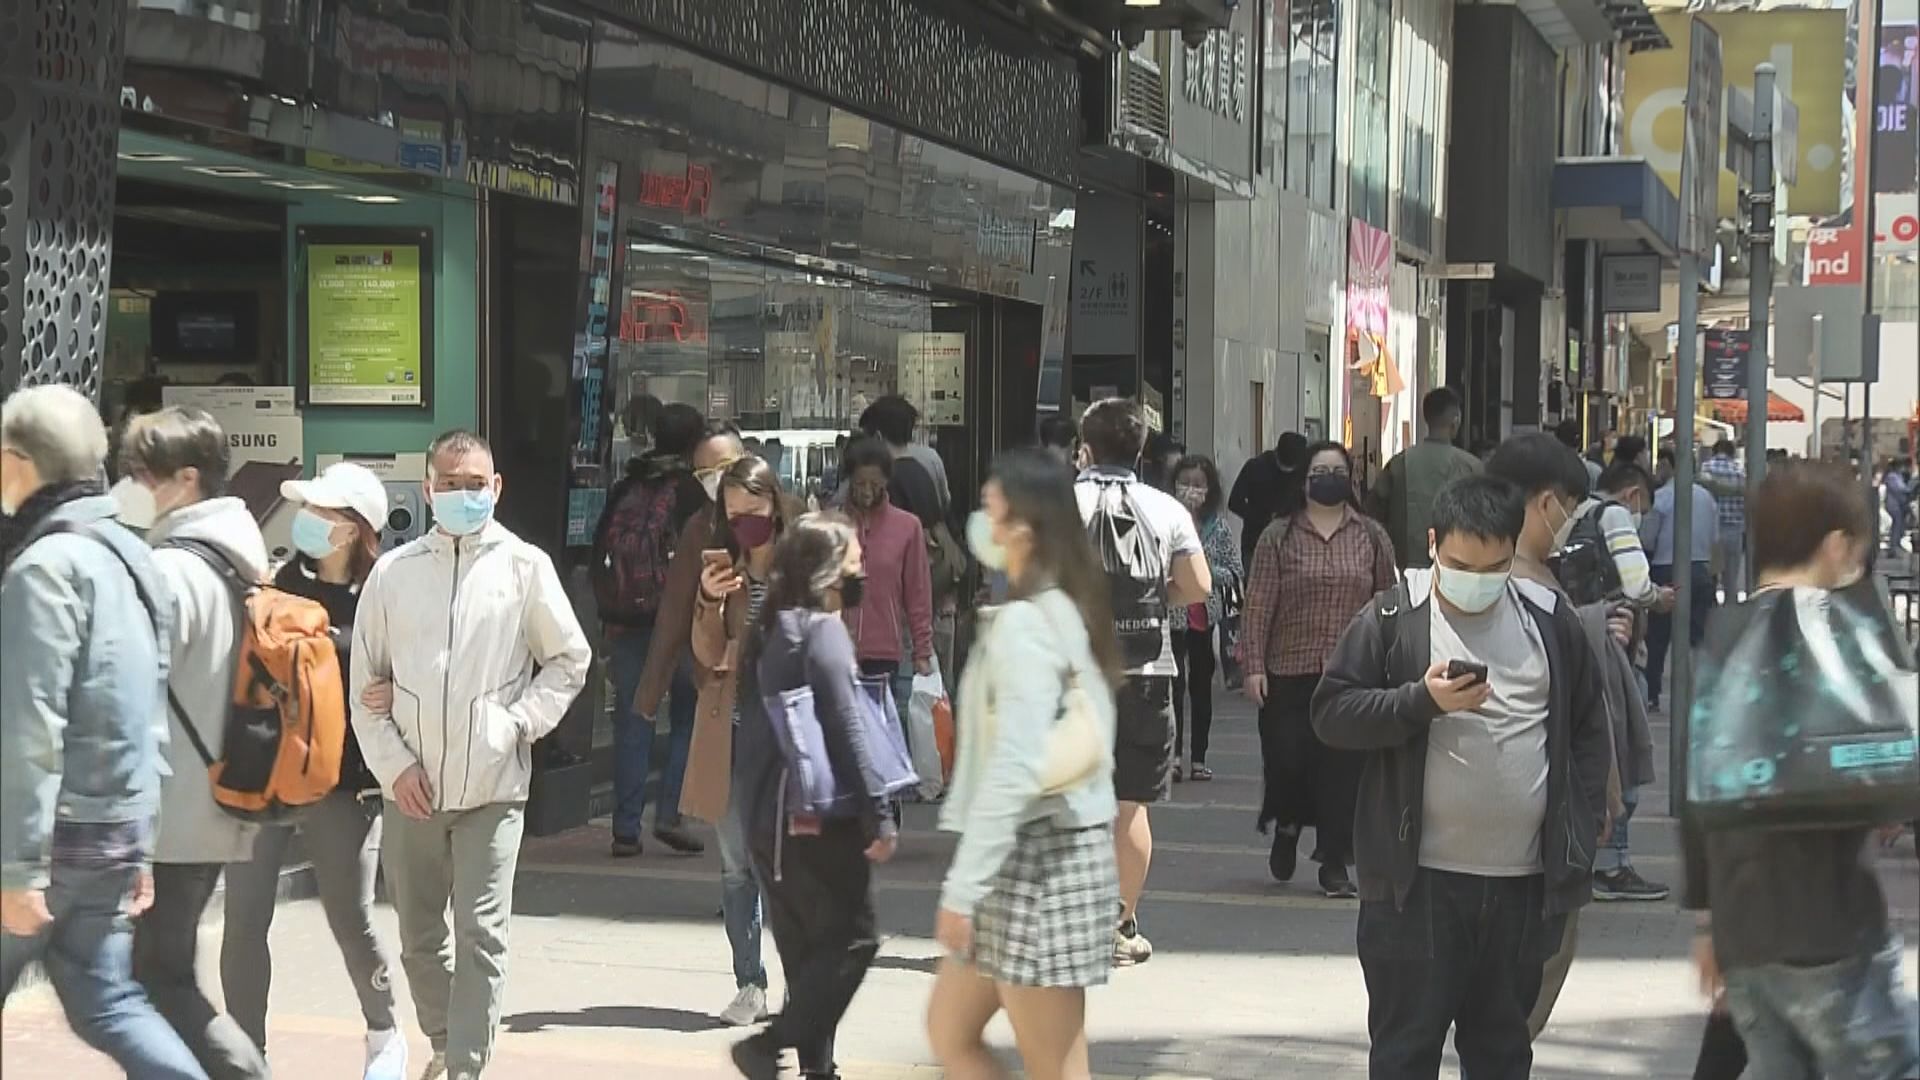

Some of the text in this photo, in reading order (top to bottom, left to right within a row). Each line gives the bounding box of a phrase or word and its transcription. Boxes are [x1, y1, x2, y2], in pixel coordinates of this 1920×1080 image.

[1873, 215, 1918, 242] O
[224, 434, 277, 448] SUNG
[1114, 617, 1159, 631] NEBO
